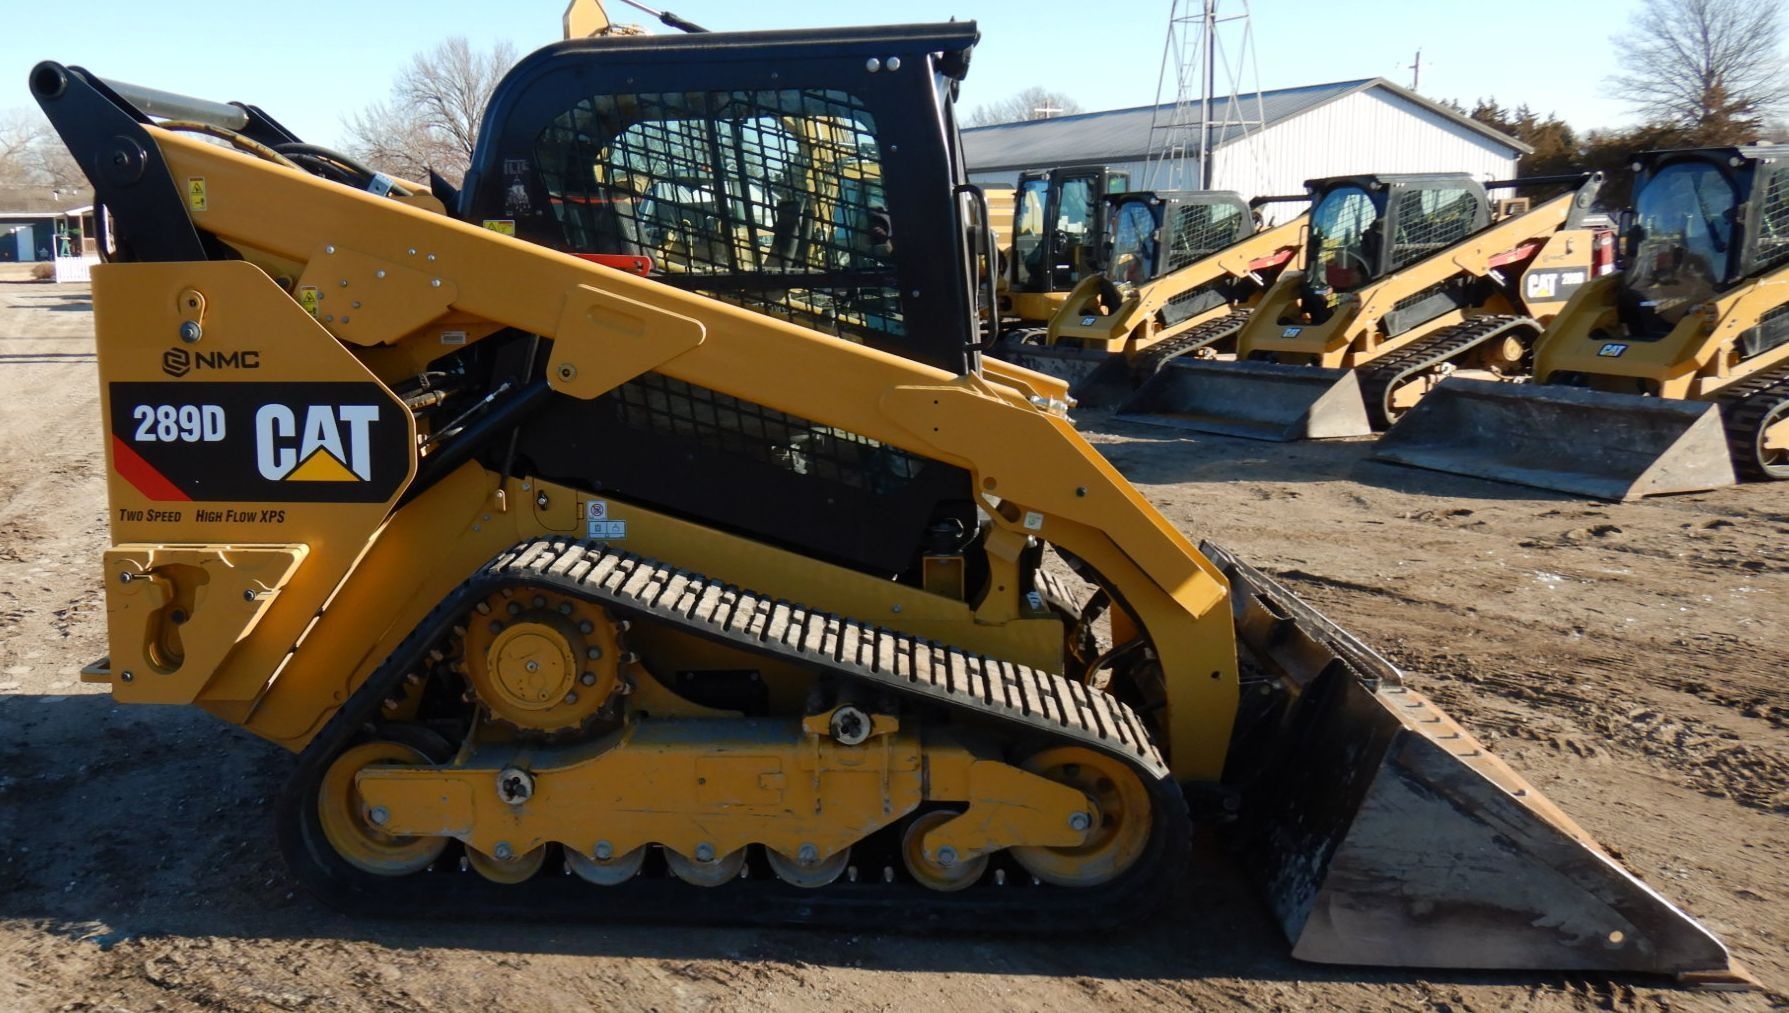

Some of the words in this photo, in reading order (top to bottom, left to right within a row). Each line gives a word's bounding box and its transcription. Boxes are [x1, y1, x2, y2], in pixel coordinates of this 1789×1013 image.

[1527, 273, 1558, 298] CAT
[195, 350, 260, 370] NMC
[1599, 344, 1627, 357] CAT
[133, 404, 227, 443] 289D
[255, 403, 380, 482] CAT
[259, 509, 286, 524] XPS
